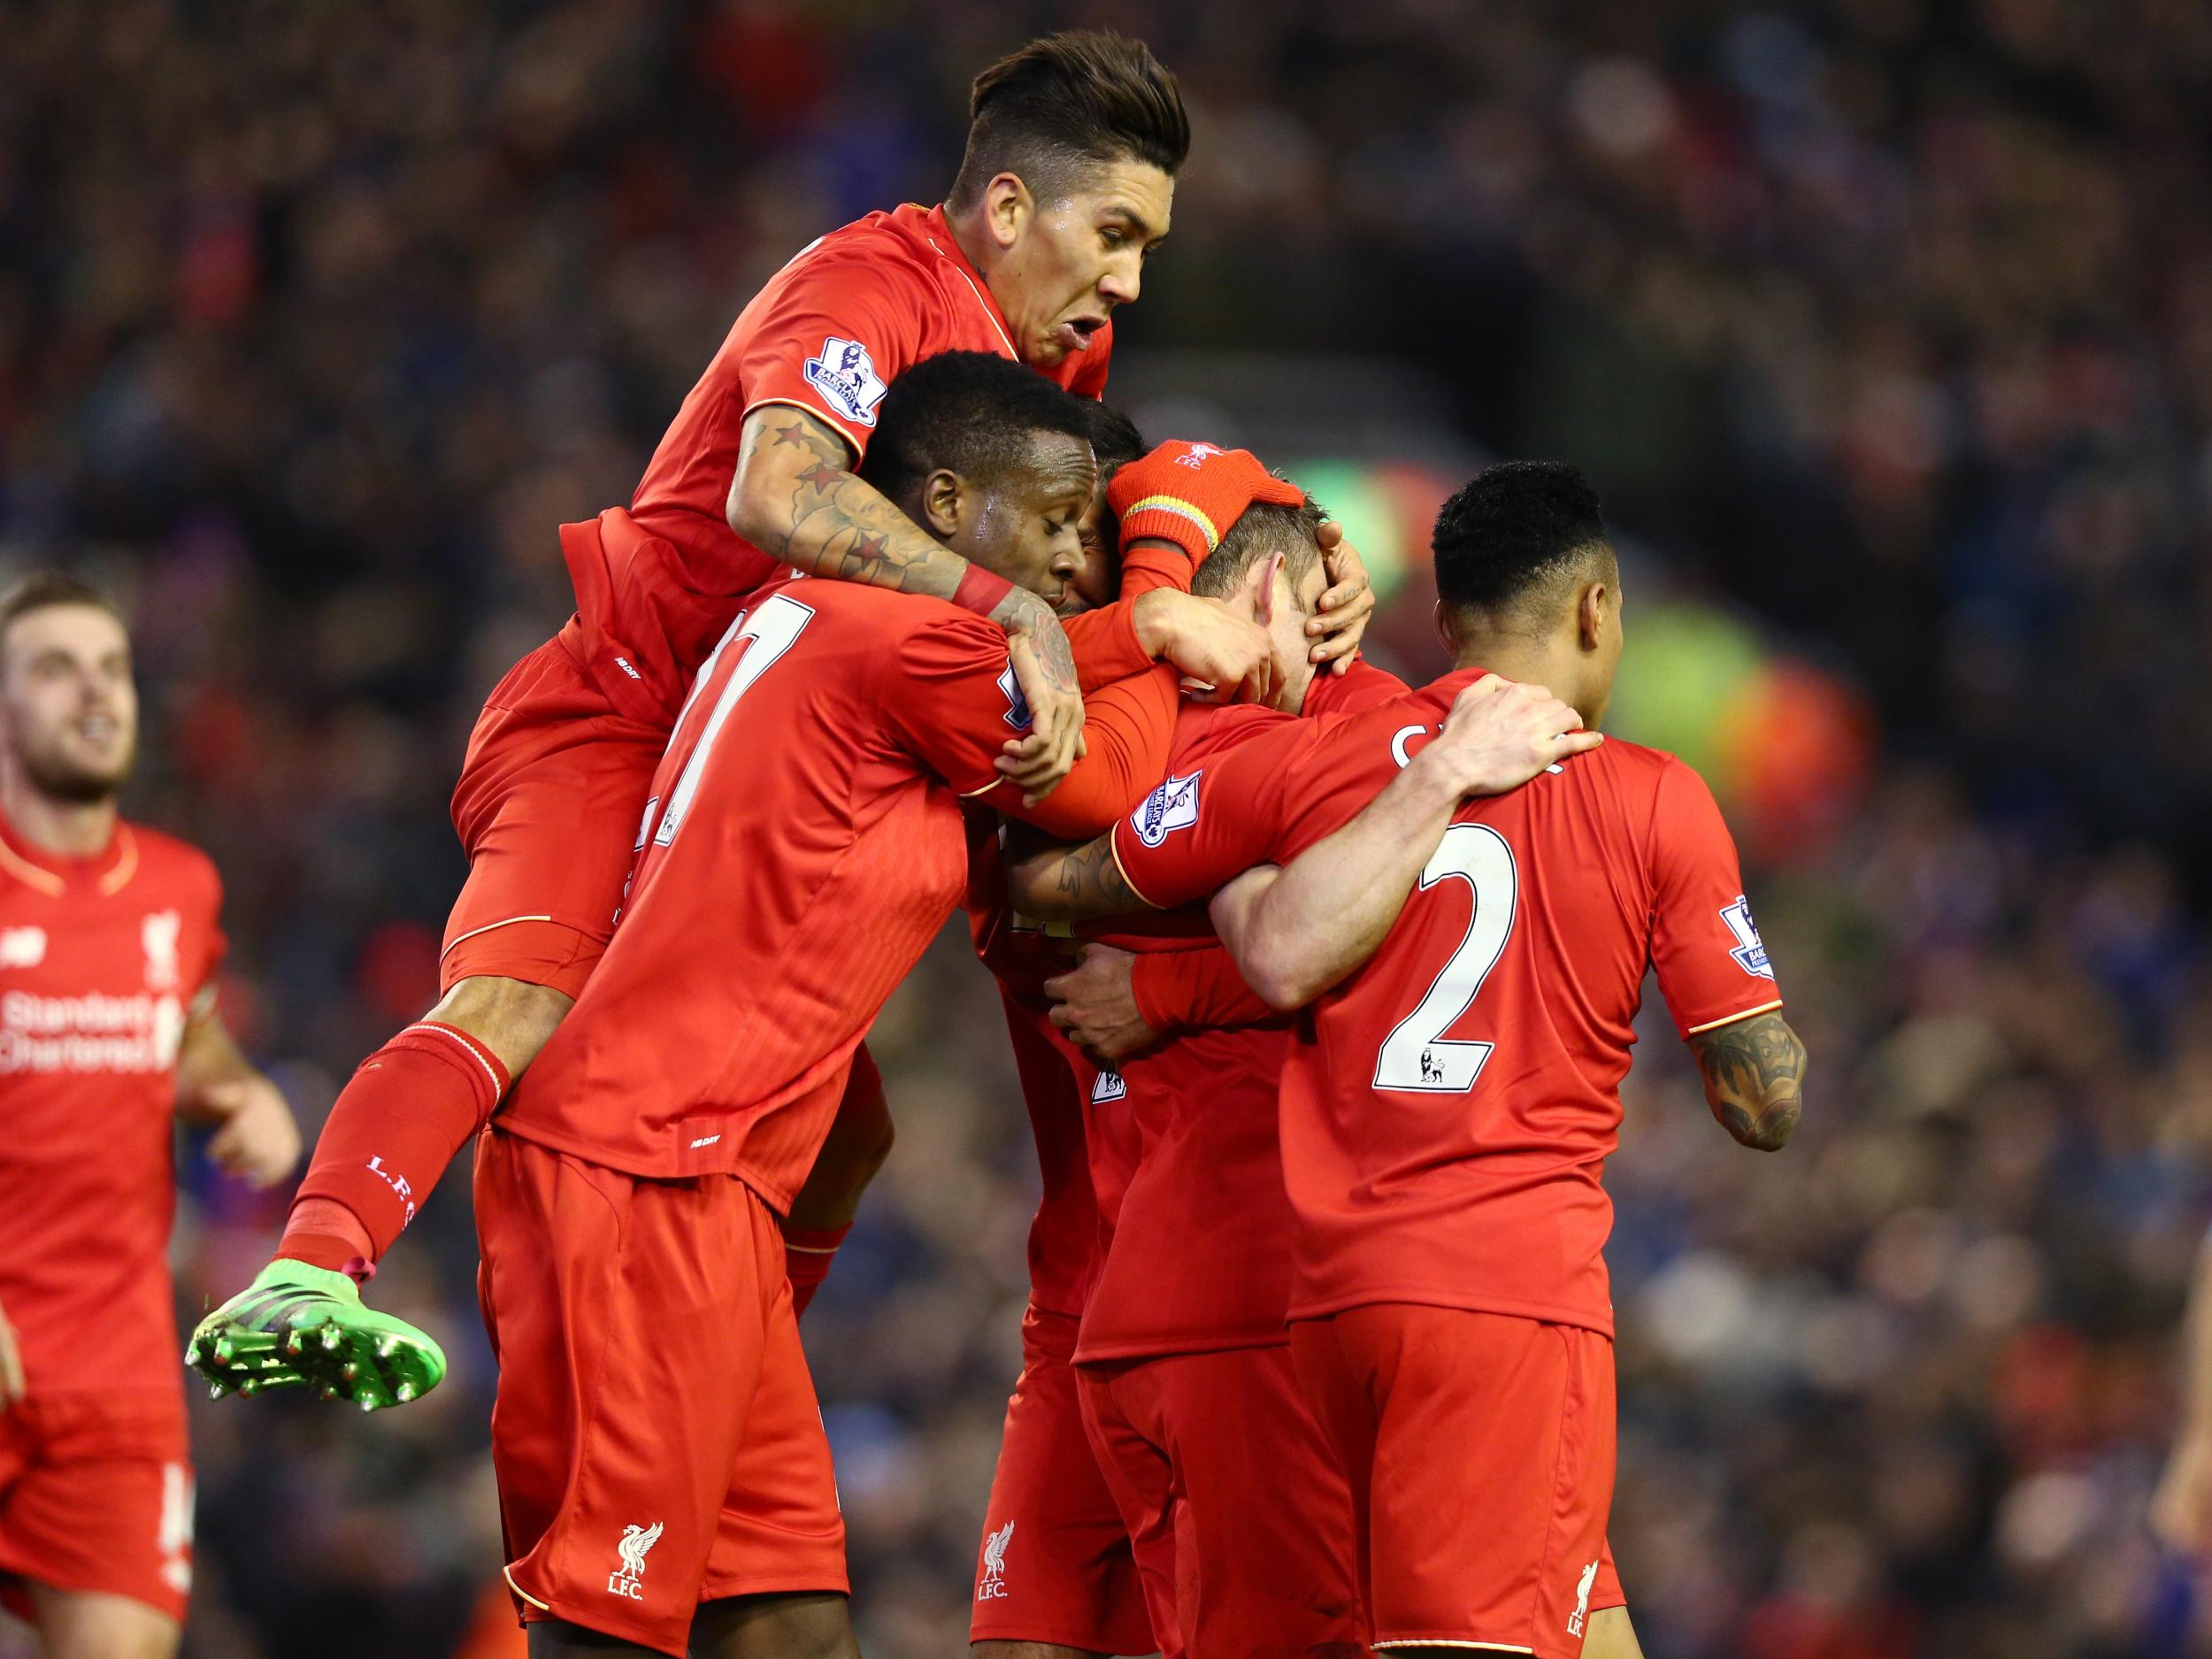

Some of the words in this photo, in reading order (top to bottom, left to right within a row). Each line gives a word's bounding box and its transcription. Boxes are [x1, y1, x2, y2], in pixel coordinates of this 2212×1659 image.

[817, 367, 857, 406] BARCLAYS
[1372, 822, 1518, 1093] 2
[607, 1575, 643, 1601] L.F.C.
[978, 1581, 1008, 1601] L.F.C.
